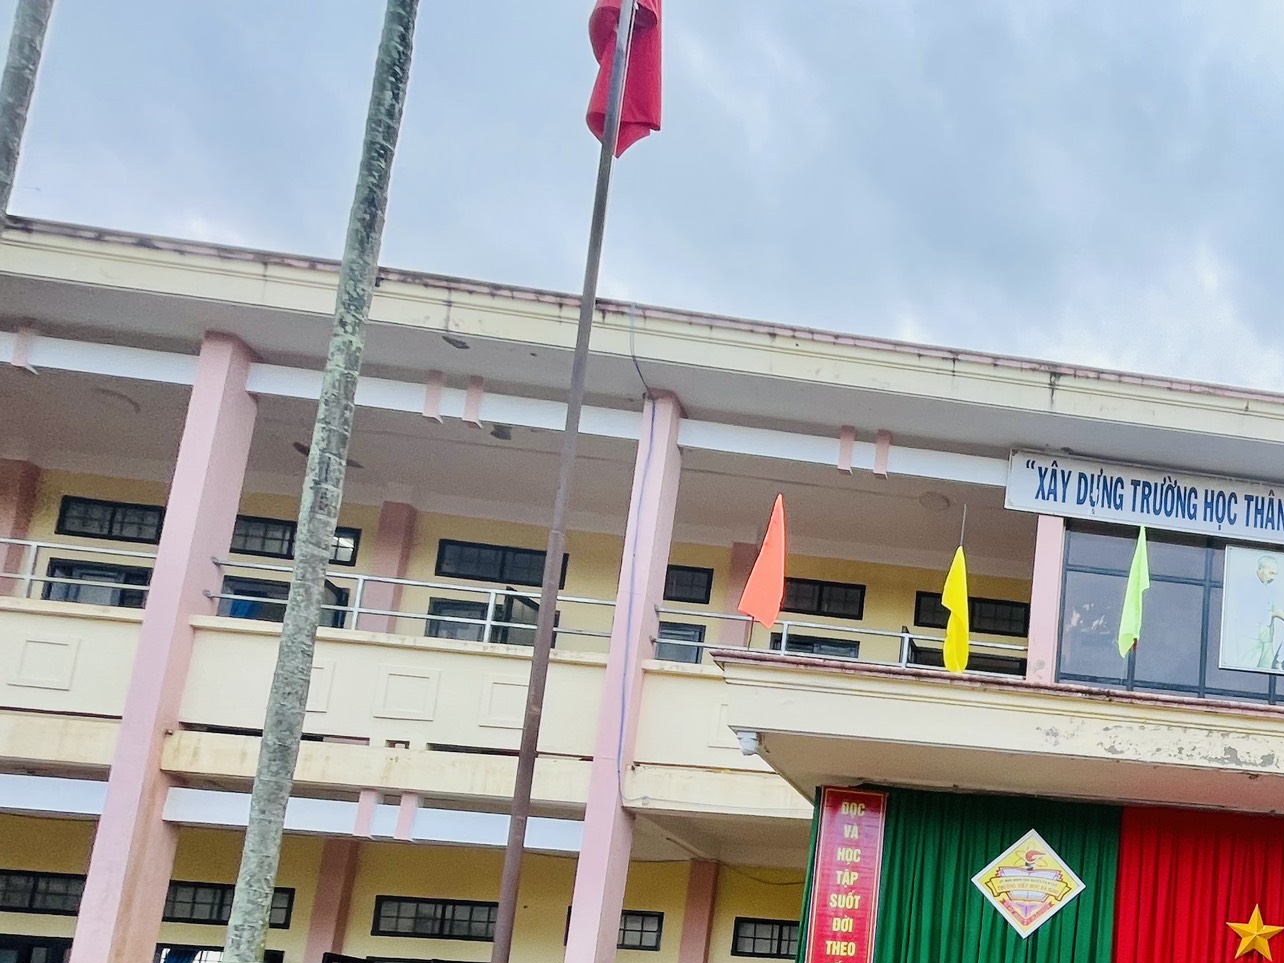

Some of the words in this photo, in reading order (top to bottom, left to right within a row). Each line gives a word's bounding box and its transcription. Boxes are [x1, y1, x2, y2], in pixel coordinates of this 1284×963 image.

[1076, 468, 1124, 514] DỰNG
[1131, 475, 1198, 521] TRƯỜNG
[1203, 489, 1237, 530] HỌC
[841, 802, 865, 819] ĐỌC
[844, 824, 859, 839] VÀ
[837, 848, 860, 865] HỌC
[835, 870, 858, 887] TẬP
[830, 891, 860, 909] SUỐT
[832, 917, 853, 933] ĐỜI
[826, 941, 855, 957] THEO
